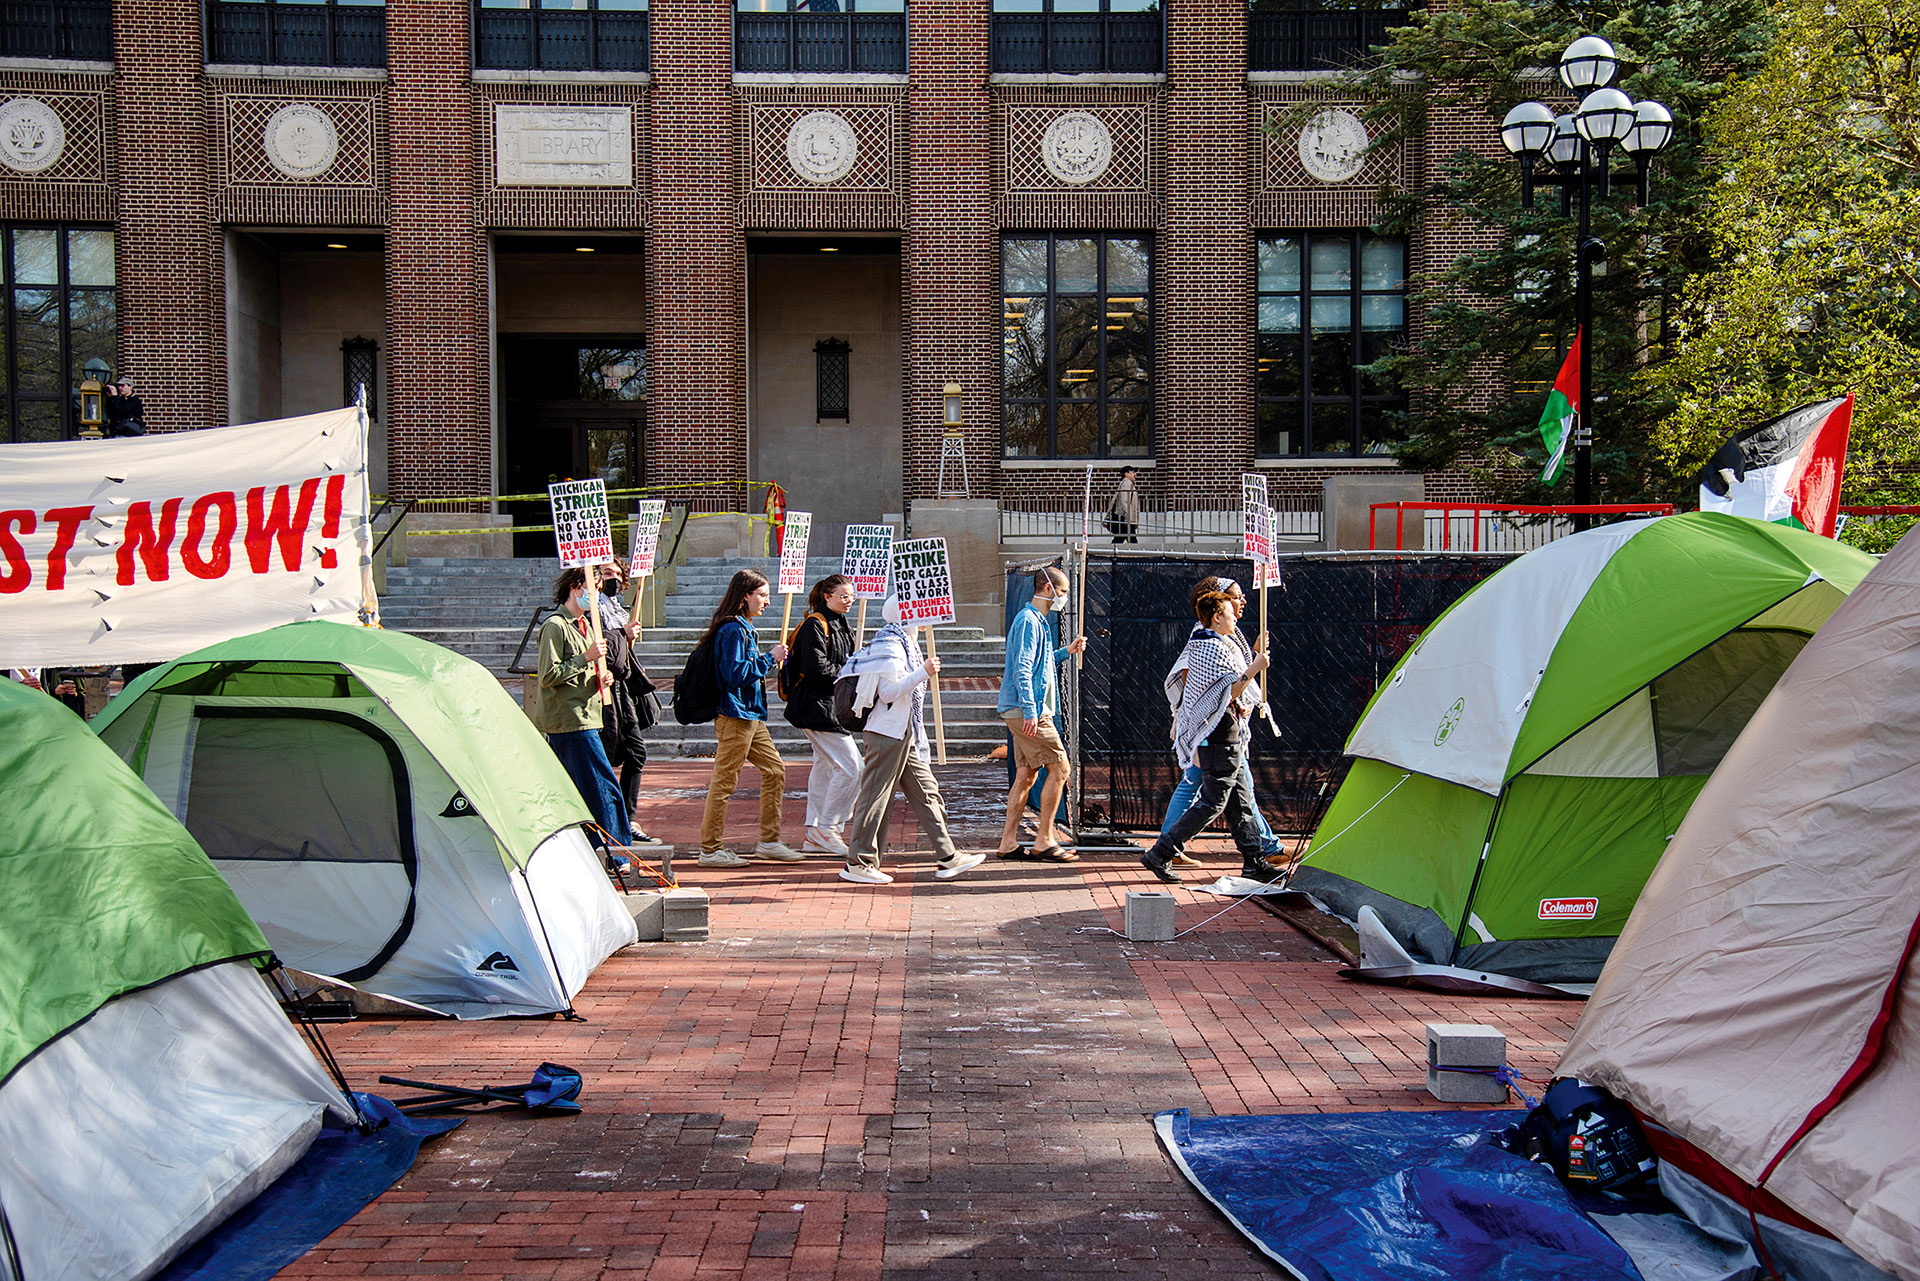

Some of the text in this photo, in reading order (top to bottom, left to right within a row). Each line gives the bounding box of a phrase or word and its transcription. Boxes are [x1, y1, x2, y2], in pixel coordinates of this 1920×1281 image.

[527, 136, 602, 155] LIBRARY
[552, 481, 603, 496] MICHIGAN
[554, 492, 604, 511] STRIKE
[556, 508, 606, 523] FOR GAZA
[1246, 514, 1255, 523] NO
[116, 474, 345, 586] NOW!
[557, 523, 572, 533] NO
[577, 519, 607, 530] CLASS
[848, 526, 892, 536] MICHIGAN
[1246, 523, 1255, 533] NO
[559, 528, 608, 542] NO WORK
[1246, 533, 1253, 541] NO
[560, 538, 610, 551] NO BUSINESS
[847, 536, 891, 549] STRIKE
[893, 539, 944, 554] MICHIGAN
[1246, 542, 1255, 551] AS
[563, 546, 611, 561] AS USUAL
[846, 550, 888, 559] FOR GAZA
[845, 559, 888, 568] NO CLASS
[893, 551, 946, 570] STRIKE
[860, 568, 886, 576] WORK
[895, 566, 947, 581] FOR GAZA
[854, 576, 886, 584] BUSINESS
[896, 577, 949, 592] NO CLASS
[856, 584, 885, 592] USUAL
[898, 587, 950, 601] NO WORK
[899, 597, 951, 610] NO BUSINESS
[901, 605, 952, 620] AS USUAL
[1543, 901, 1585, 914] Coleman
